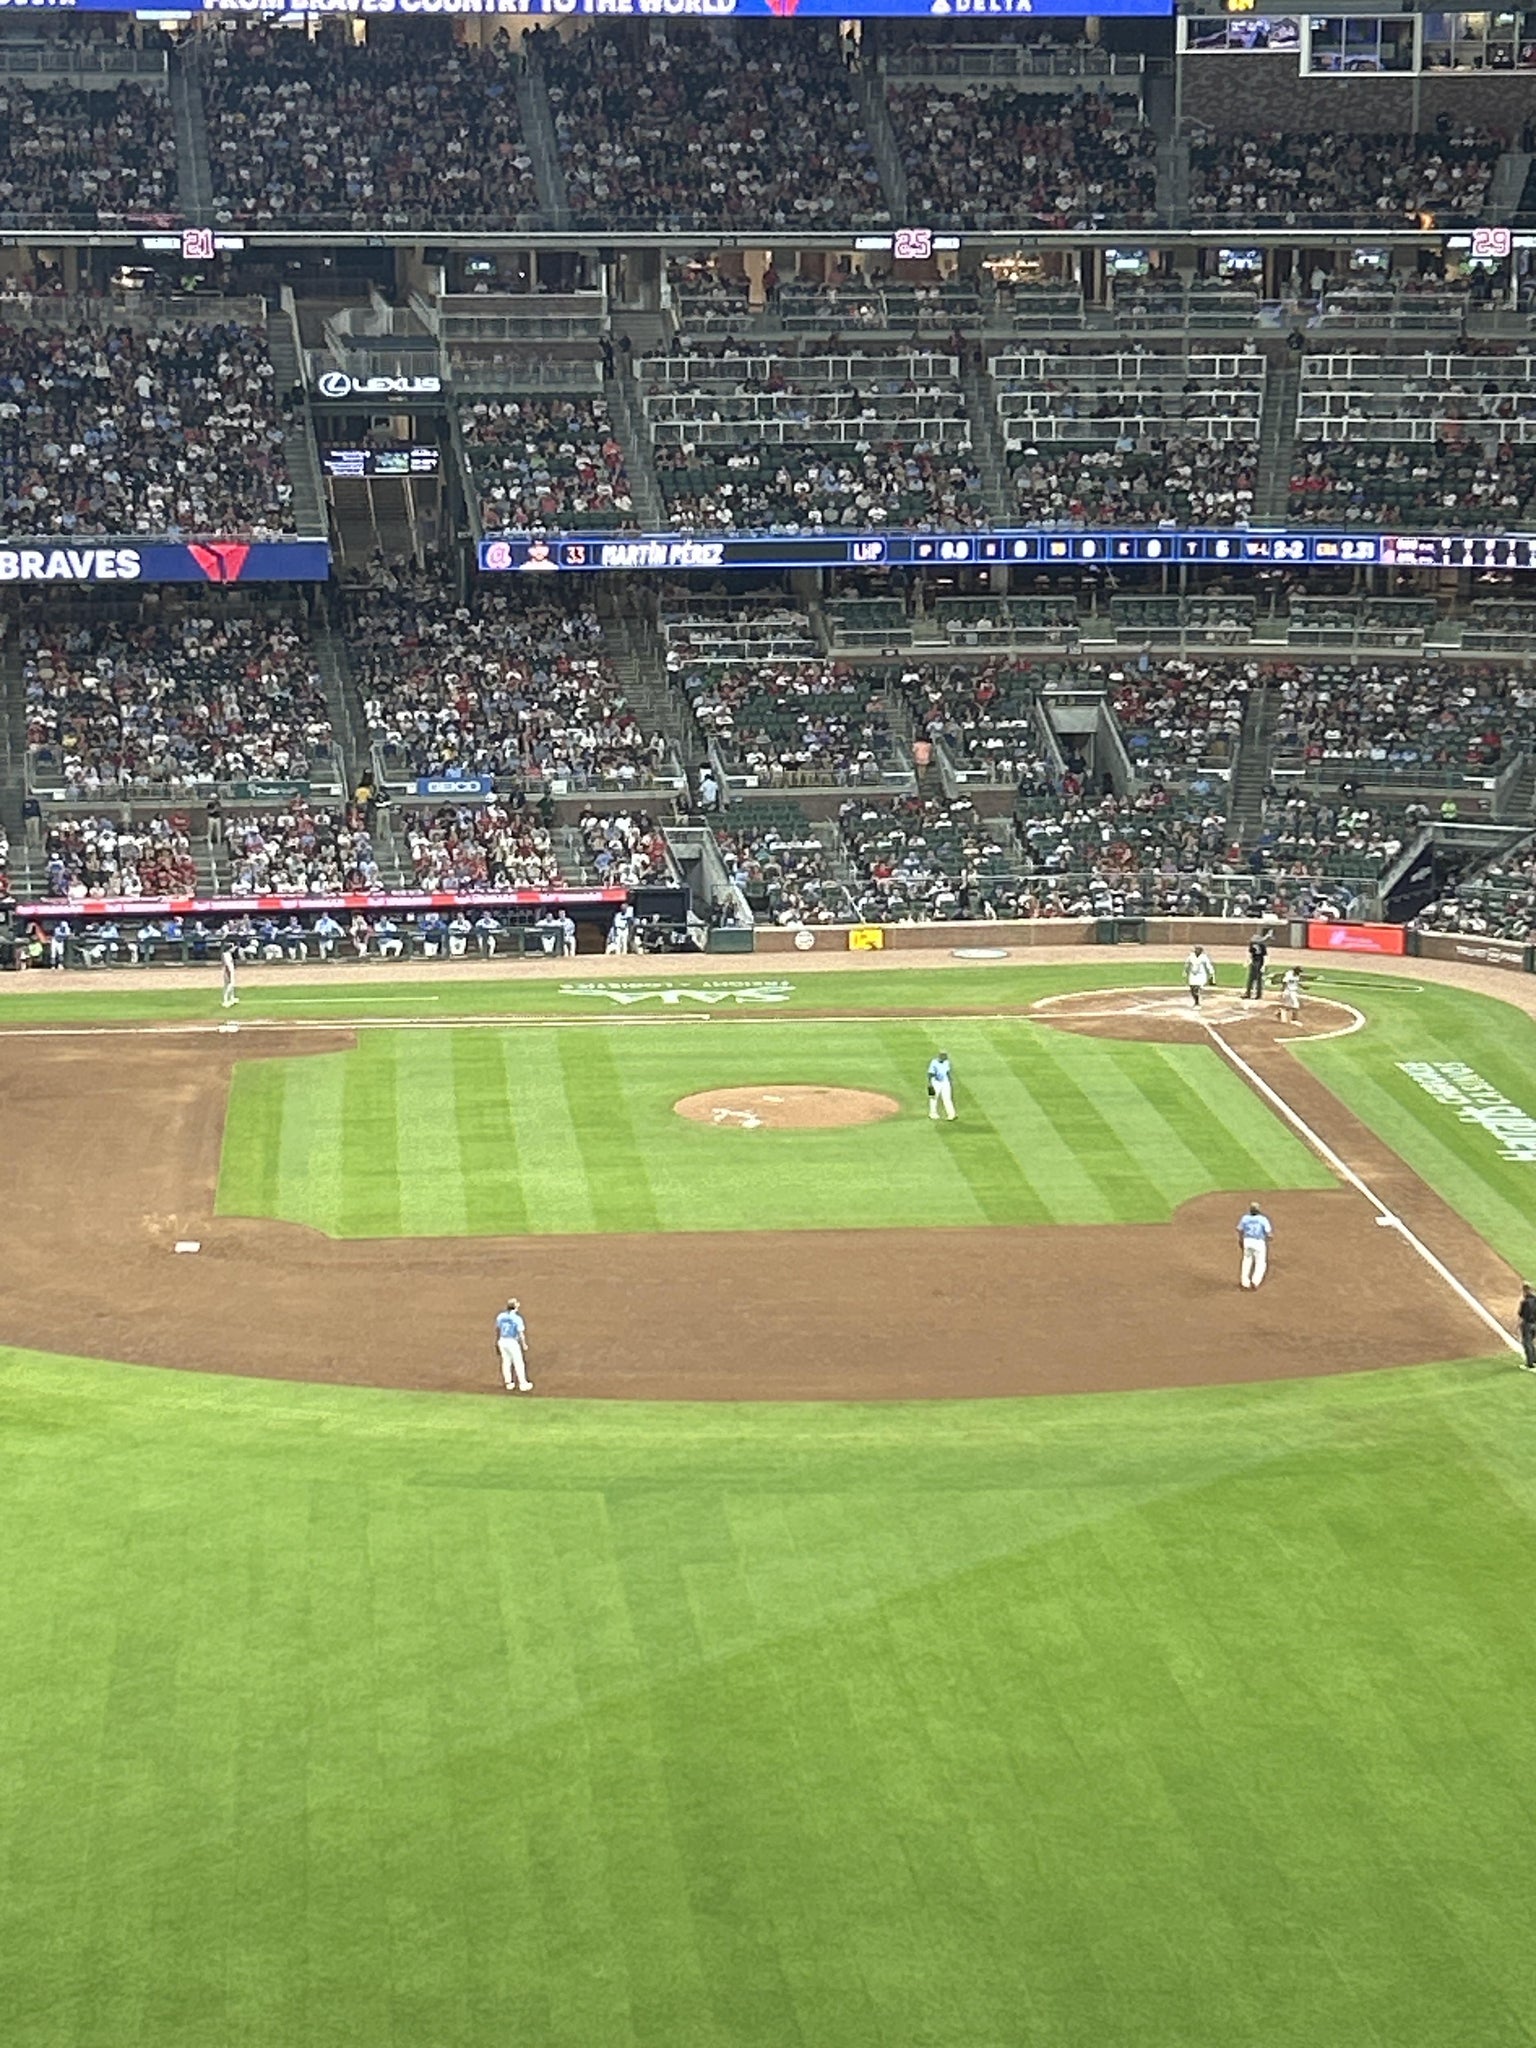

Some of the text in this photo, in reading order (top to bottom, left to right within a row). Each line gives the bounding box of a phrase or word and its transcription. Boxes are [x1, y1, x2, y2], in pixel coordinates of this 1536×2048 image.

[183, 228, 214, 258] 21
[894, 228, 932, 259] 25
[1472, 227, 1511, 257] 29
[352, 376, 441, 392] LEXUS
[0, 548, 141, 580] BRAVES
